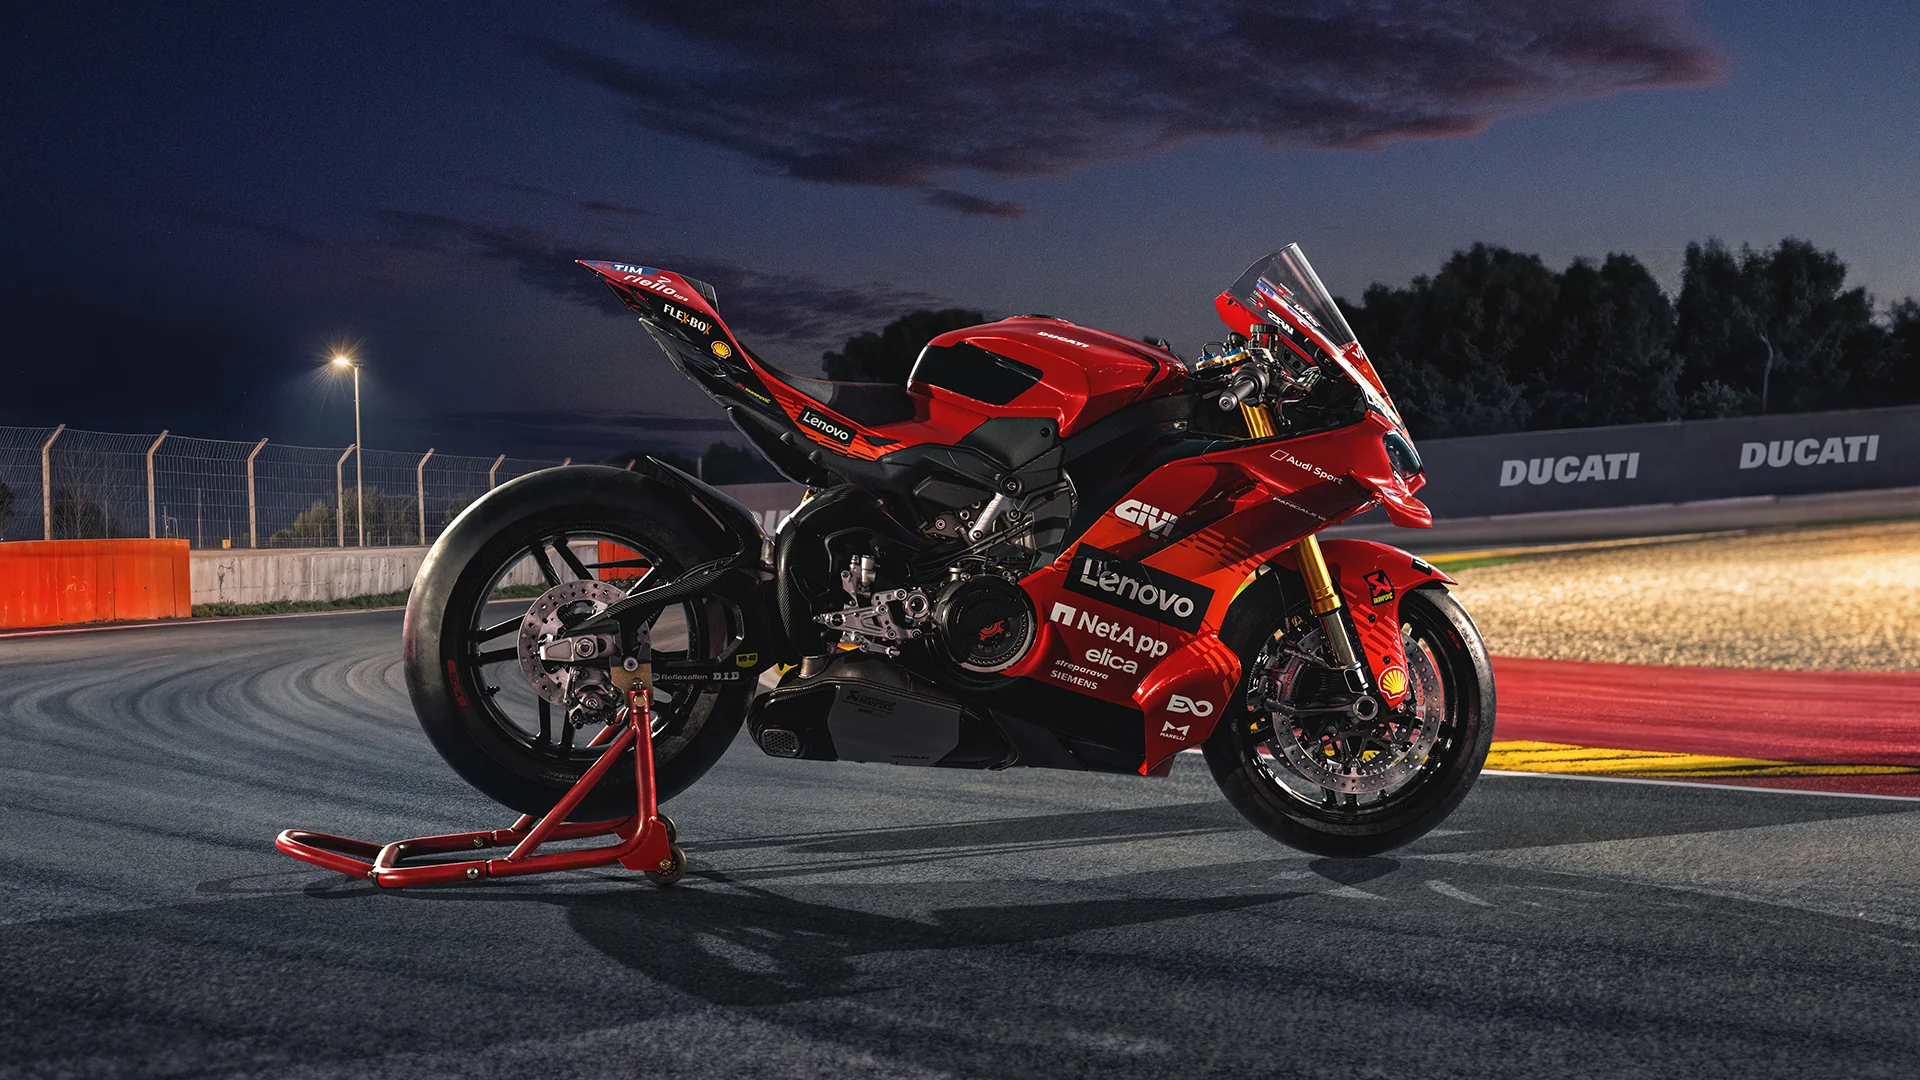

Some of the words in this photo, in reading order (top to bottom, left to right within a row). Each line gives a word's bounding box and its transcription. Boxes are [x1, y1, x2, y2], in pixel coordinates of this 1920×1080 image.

[614, 264, 642, 275] TIM
[624, 275, 676, 295] riello
[663, 303, 713, 335] FLEX-BOX
[1037, 331, 1089, 348] DUCATI
[802, 411, 849, 441] Lenovo
[1739, 435, 1879, 469] DUCATI
[1286, 455, 1312, 472] Audi
[1313, 466, 1344, 486] Sport
[1500, 452, 1640, 487] DUCATI
[1115, 499, 1178, 537] GIVI
[1080, 558, 1194, 618] Lenovo
[1077, 611, 1168, 658] NetApp
[1055, 659, 1109, 680] streparava
[1085, 648, 1139, 674] elica
[1050, 670, 1098, 690] SIEMENS
[1160, 732, 1186, 741] MARELLI
